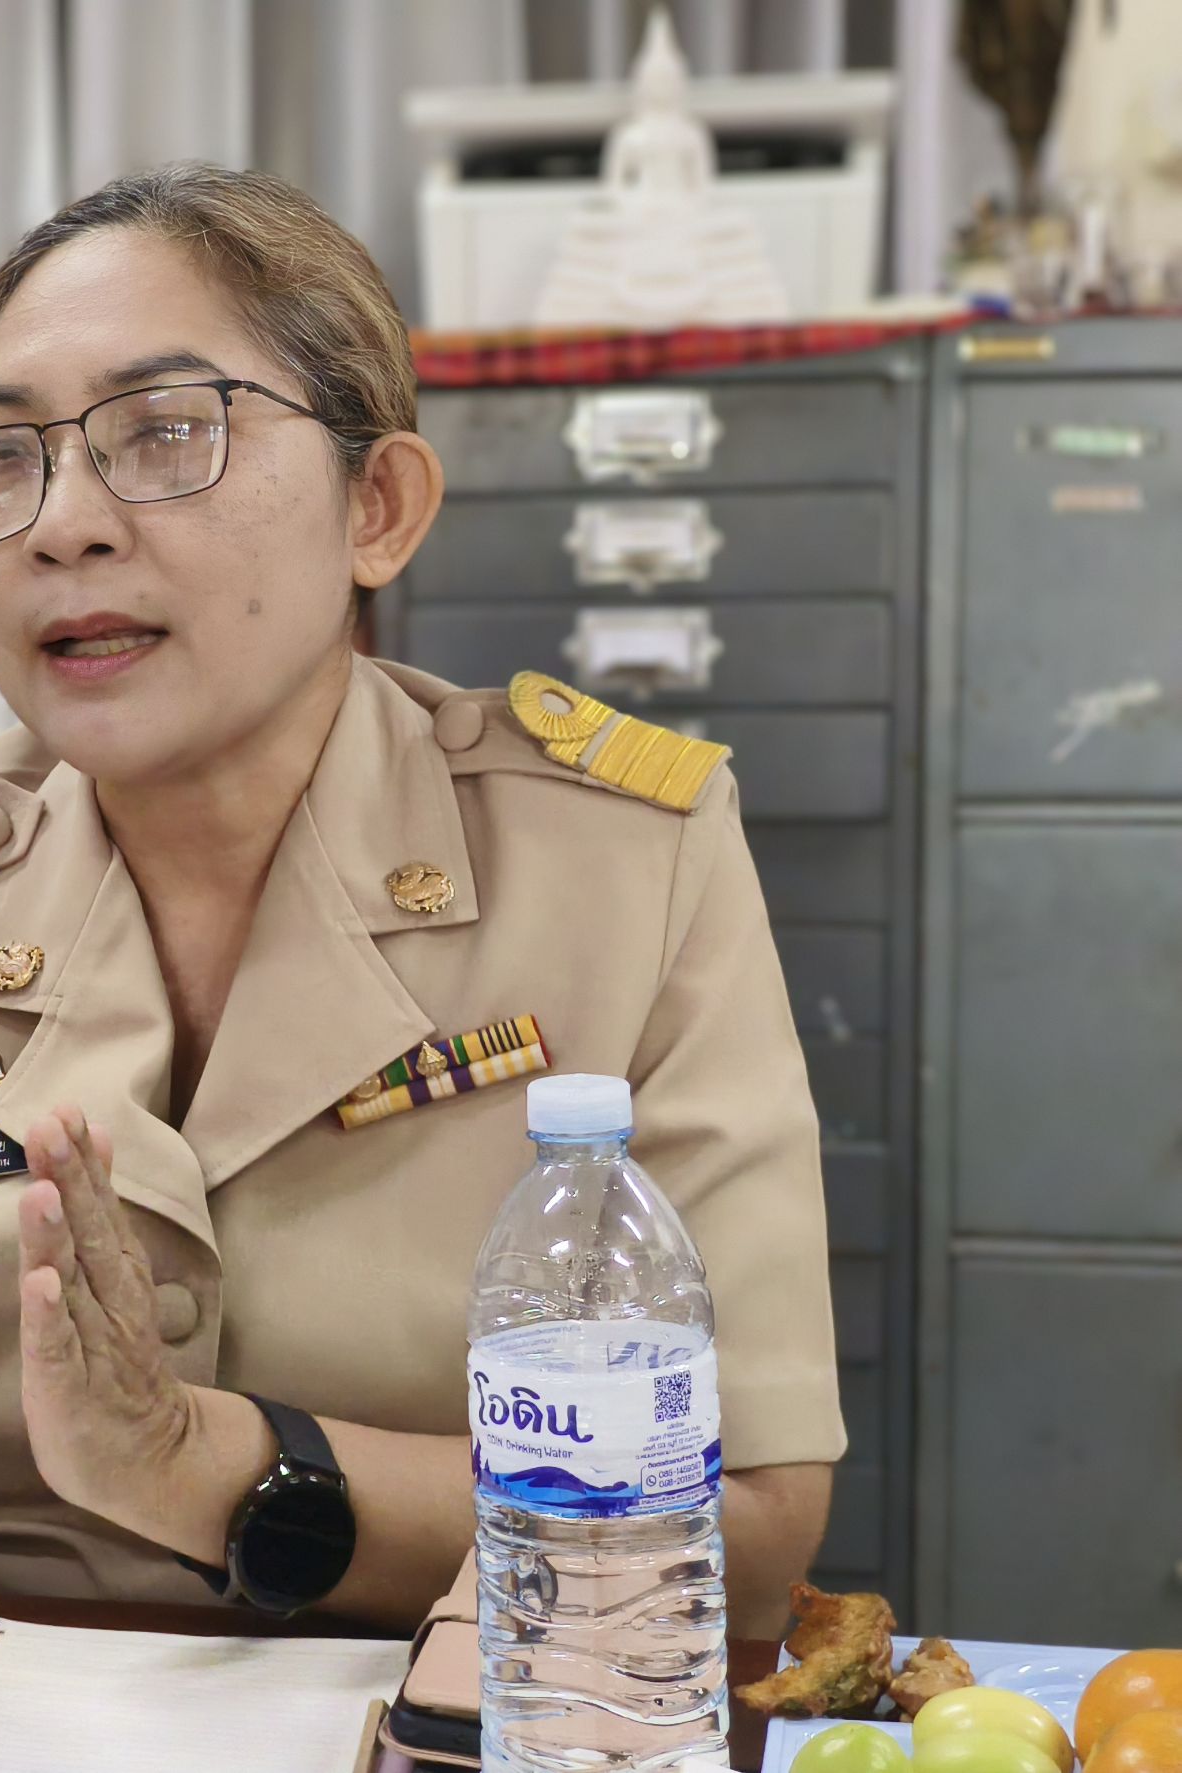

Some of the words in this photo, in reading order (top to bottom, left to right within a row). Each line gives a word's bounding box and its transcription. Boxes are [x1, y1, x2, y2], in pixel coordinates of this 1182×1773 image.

[473, 1371, 594, 1443] โอดิน
[506, 1439, 543, 1459] Drinking
[544, 1446, 574, 1460] Water
